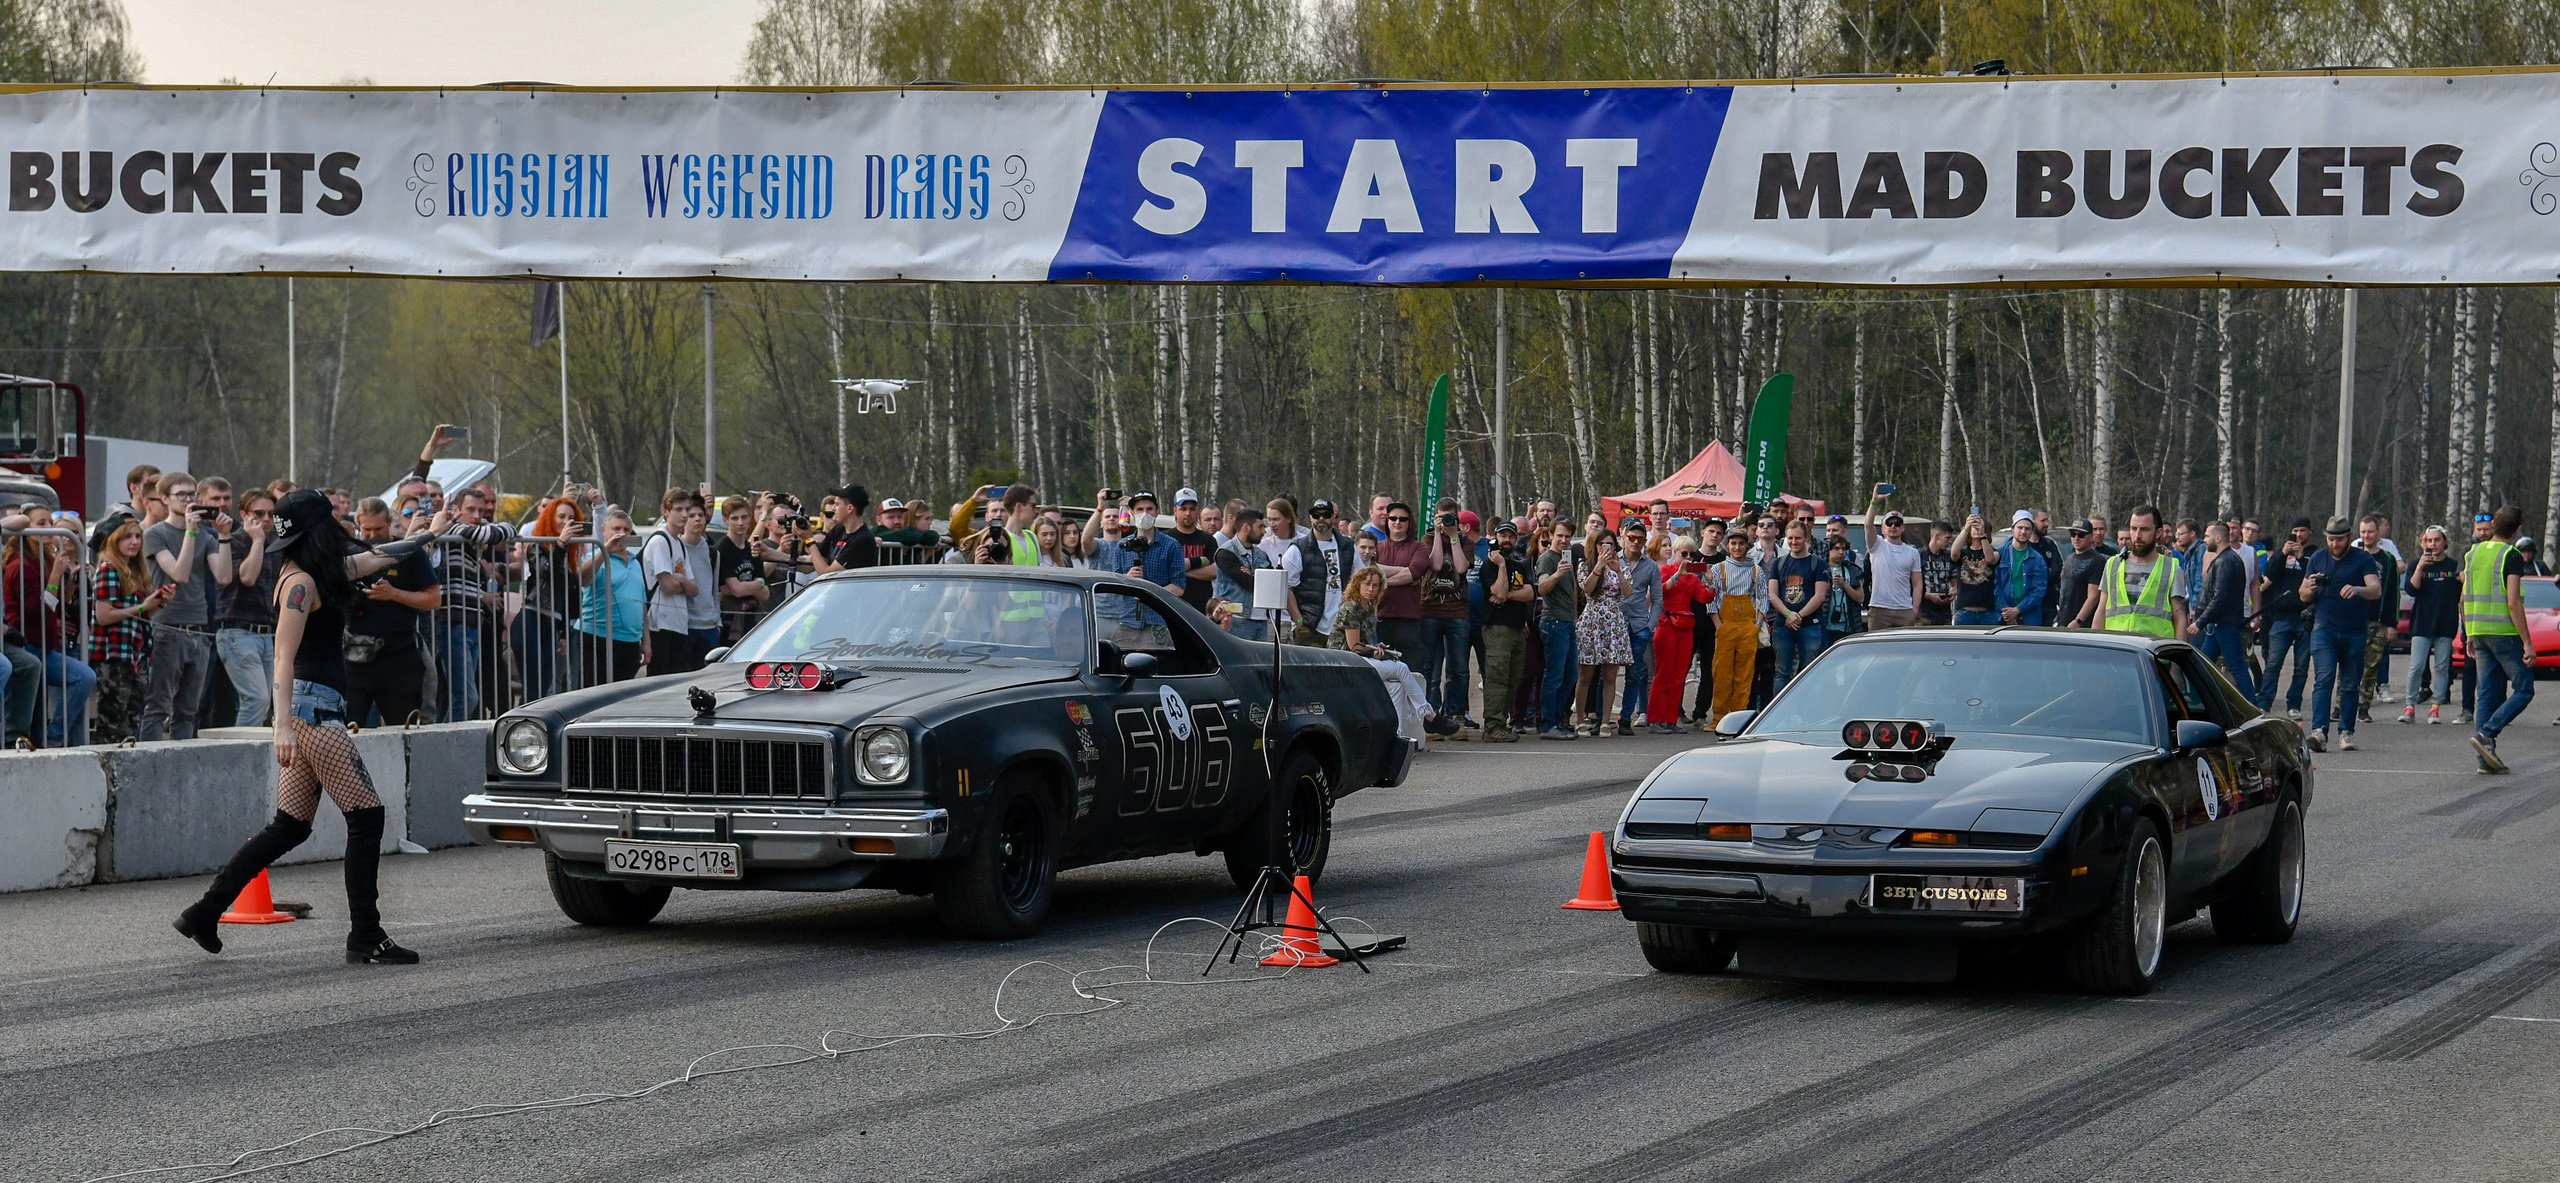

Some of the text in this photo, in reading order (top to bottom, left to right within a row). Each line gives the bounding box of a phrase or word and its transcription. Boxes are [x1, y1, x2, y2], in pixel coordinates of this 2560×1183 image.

[9, 150, 363, 215] BUCKETS
[447, 152, 610, 218] RUSSIAN
[1132, 137, 1638, 235] START
[1753, 143, 2465, 220] MAD BUCKETS
[1165, 694, 1184, 721] 43
[1114, 703, 1233, 817] 606
[699, 850, 731, 868] 178
[706, 866, 724, 874] RUS
[1882, 886, 2008, 901] 3BT CUSTOMS
